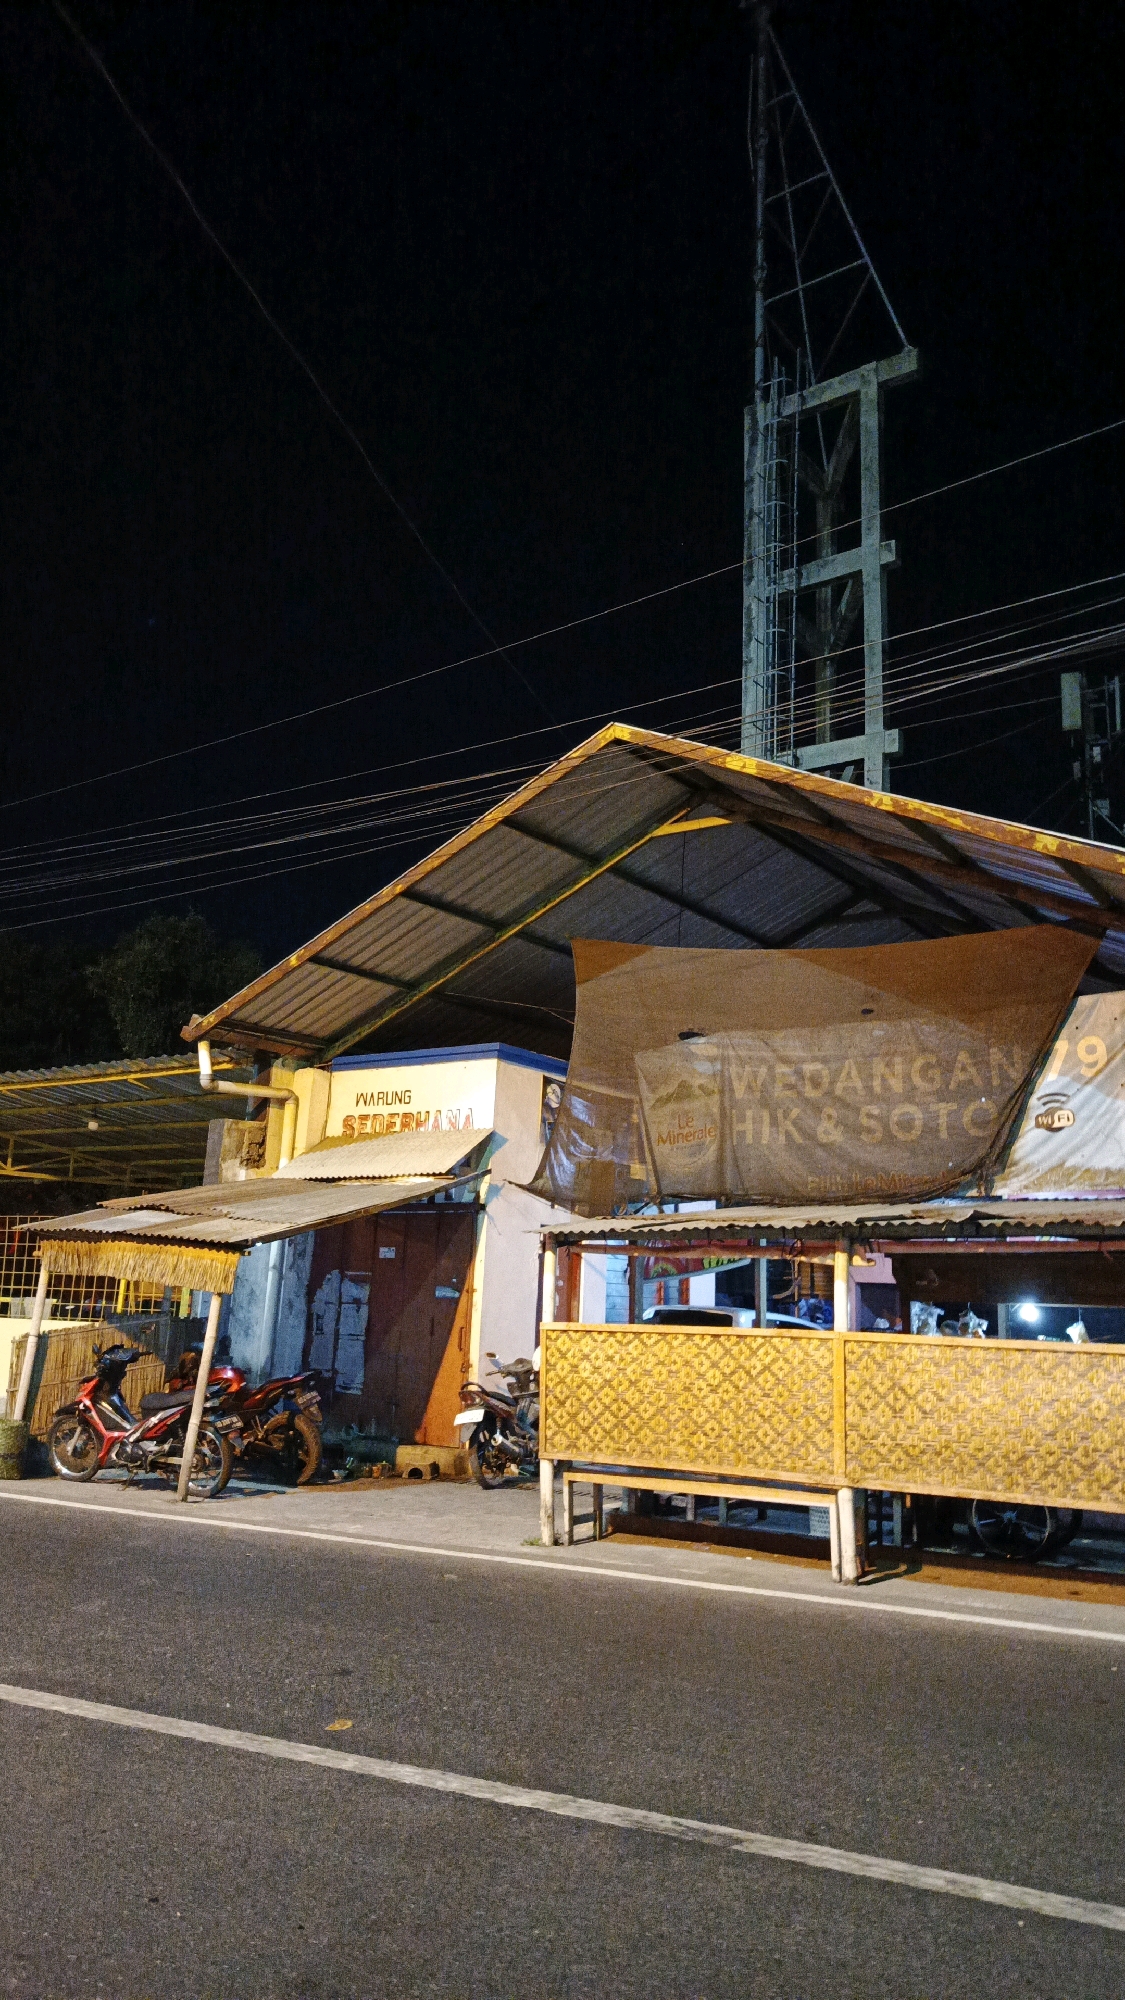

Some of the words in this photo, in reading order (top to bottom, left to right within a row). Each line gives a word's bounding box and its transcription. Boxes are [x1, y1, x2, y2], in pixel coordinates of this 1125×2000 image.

[730, 1046, 1024, 1099] WEDANGAN
[355, 1089, 412, 1107] WARUNG
[342, 1108, 474, 1138] SEDERHANA
[657, 1122, 717, 1147] Minerale
[677, 1114, 694, 1130] Le
[732, 1107, 804, 1144] HIK
[816, 1106, 844, 1143] &
[859, 1099, 999, 1143] SOTO
